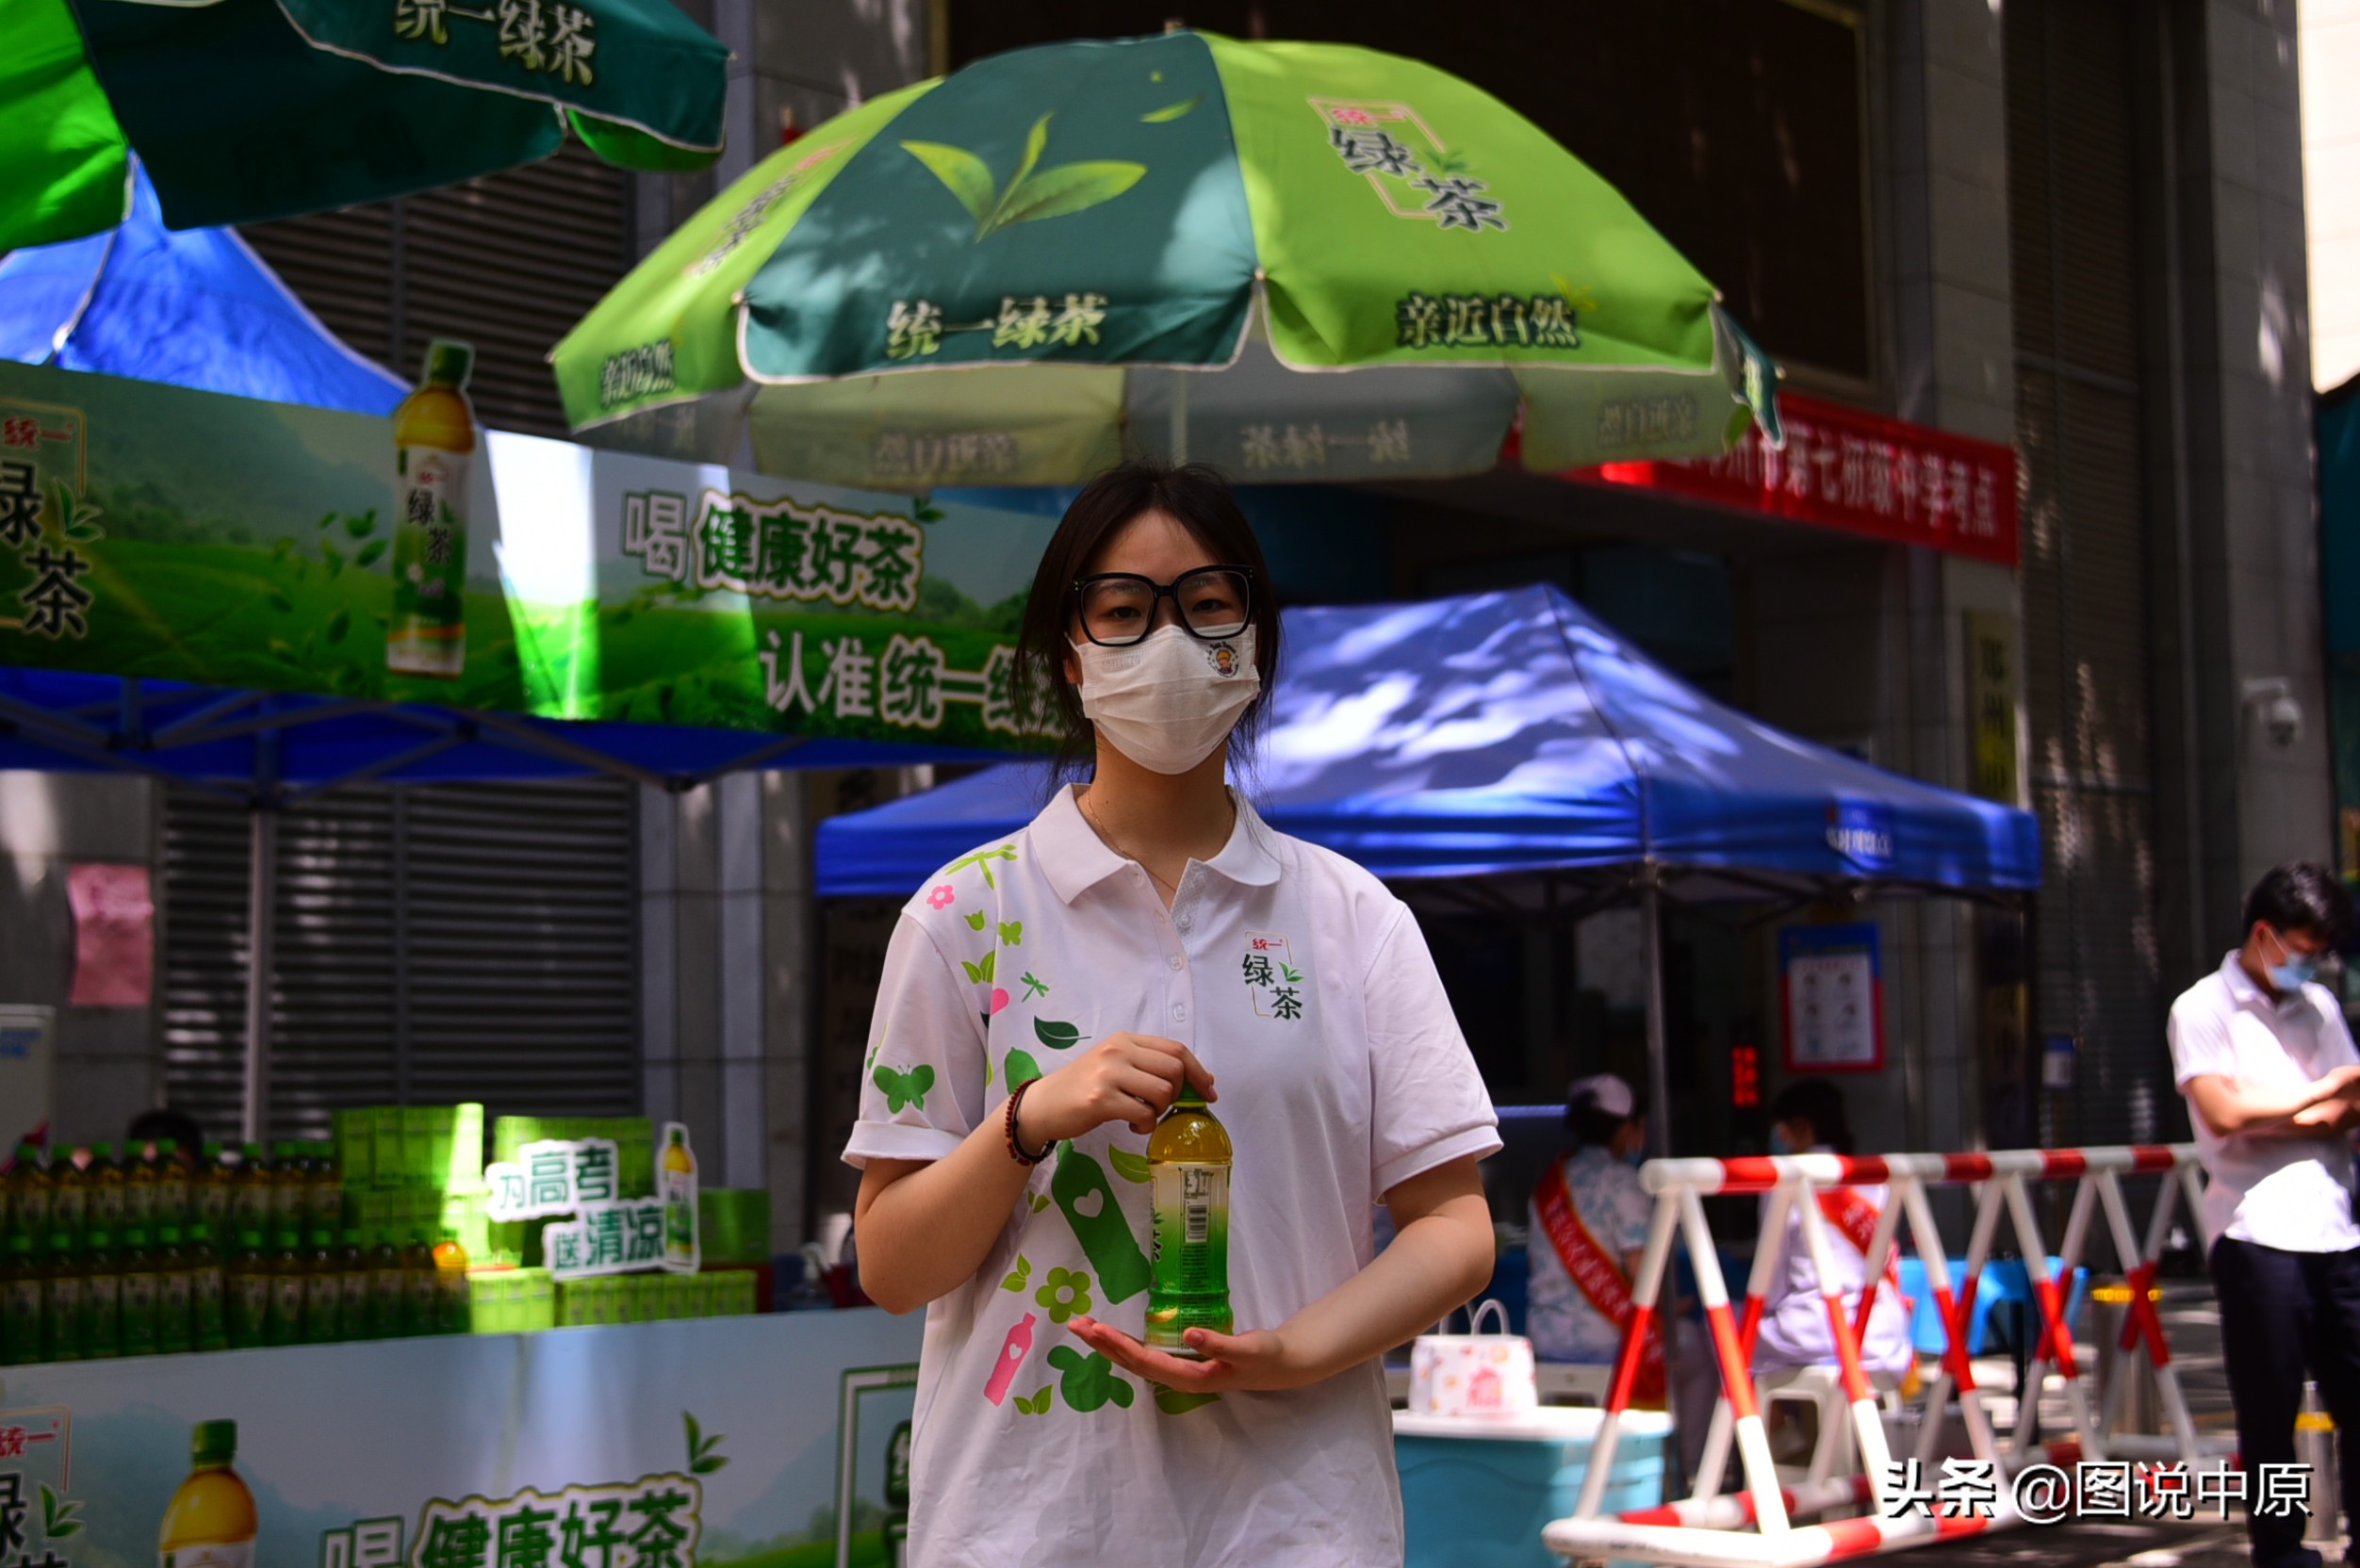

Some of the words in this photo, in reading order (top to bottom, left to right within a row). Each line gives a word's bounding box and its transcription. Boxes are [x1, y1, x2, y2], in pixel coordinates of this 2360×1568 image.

[394, 0, 596, 87] 统一绿茶
[887, 293, 1108, 360] 统一绿茶
[1401, 294, 1578, 347] 亲近自然
[624, 492, 919, 605] 喝健康好茶
[759, 629, 1074, 733] 认准统一绿
[1242, 954, 1303, 1020] 绿茶
[500, 1146, 612, 1210] 为高考
[554, 1205, 665, 1269] 送清凉
